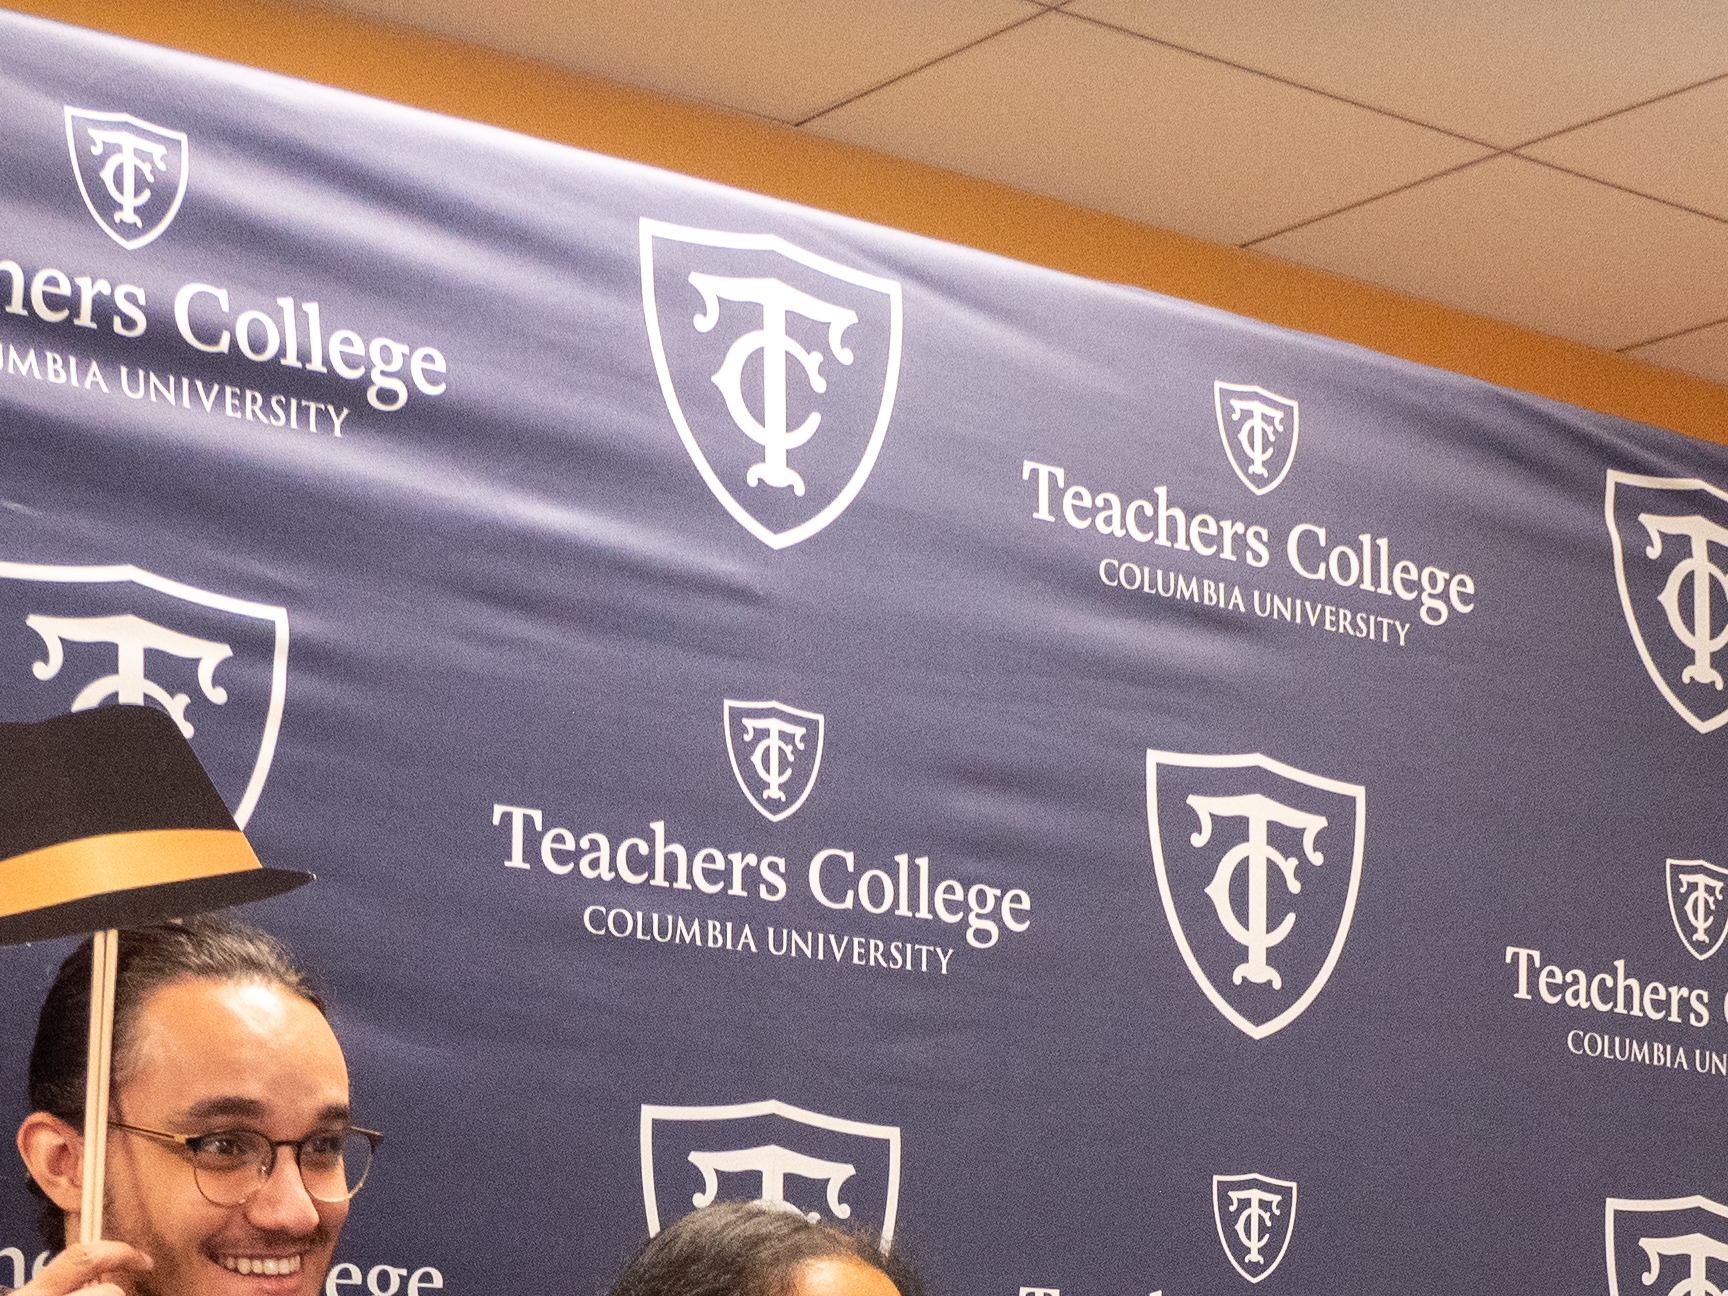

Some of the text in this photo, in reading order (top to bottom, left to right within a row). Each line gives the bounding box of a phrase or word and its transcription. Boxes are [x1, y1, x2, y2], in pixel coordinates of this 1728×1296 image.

[174, 282, 447, 411] College
[120, 366, 349, 437] UNIVERSITY
[1022, 460, 1476, 626] Teachers College
[1099, 558, 1412, 647] COLUMBIA UNIVERSITY
[492, 804, 1032, 949] Teachers College
[583, 904, 955, 975] COLUMBIA UNIVERSITY
[1505, 946, 1711, 1029] Teachers
[1567, 1030, 1689, 1072] COLUMBIA
